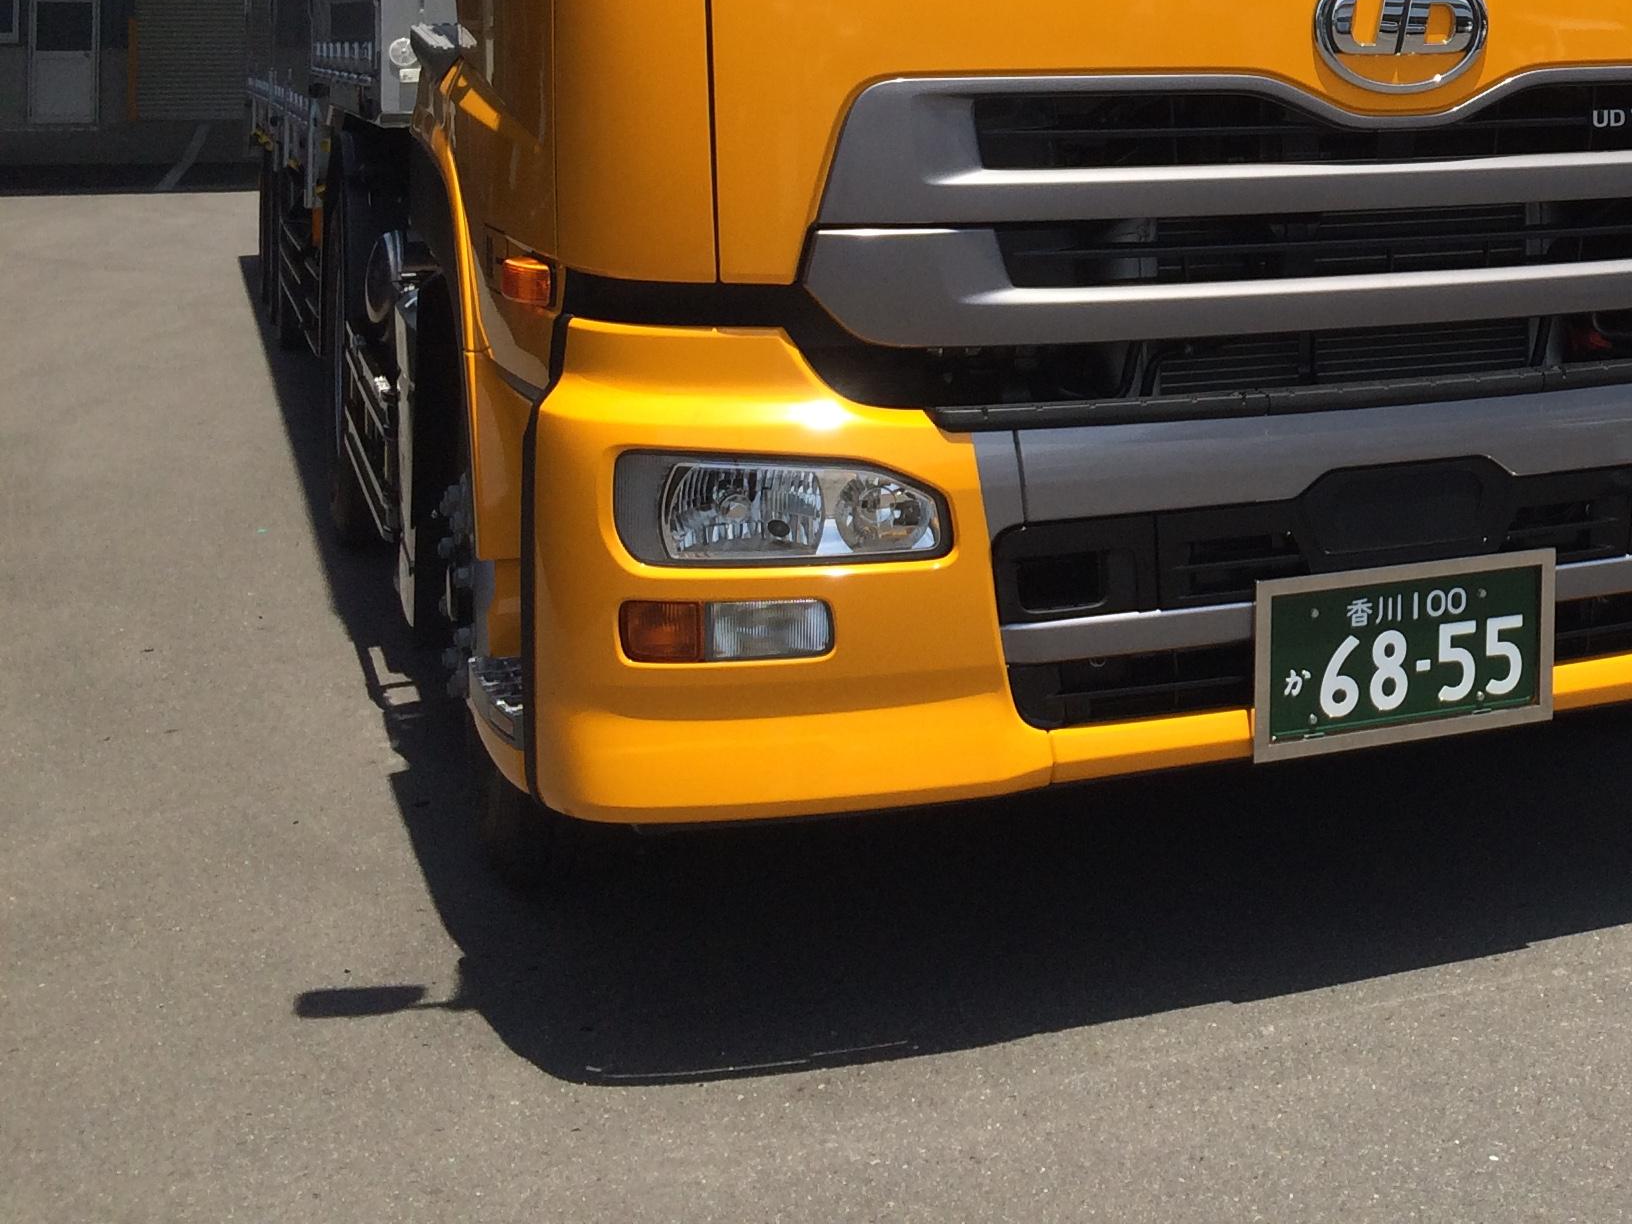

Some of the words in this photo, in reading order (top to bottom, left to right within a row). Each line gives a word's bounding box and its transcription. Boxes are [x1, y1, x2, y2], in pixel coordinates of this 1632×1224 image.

[1592, 109, 1626, 128] UD
[1284, 669, 1311, 696] か
[1320, 614, 1524, 718] 68-55
